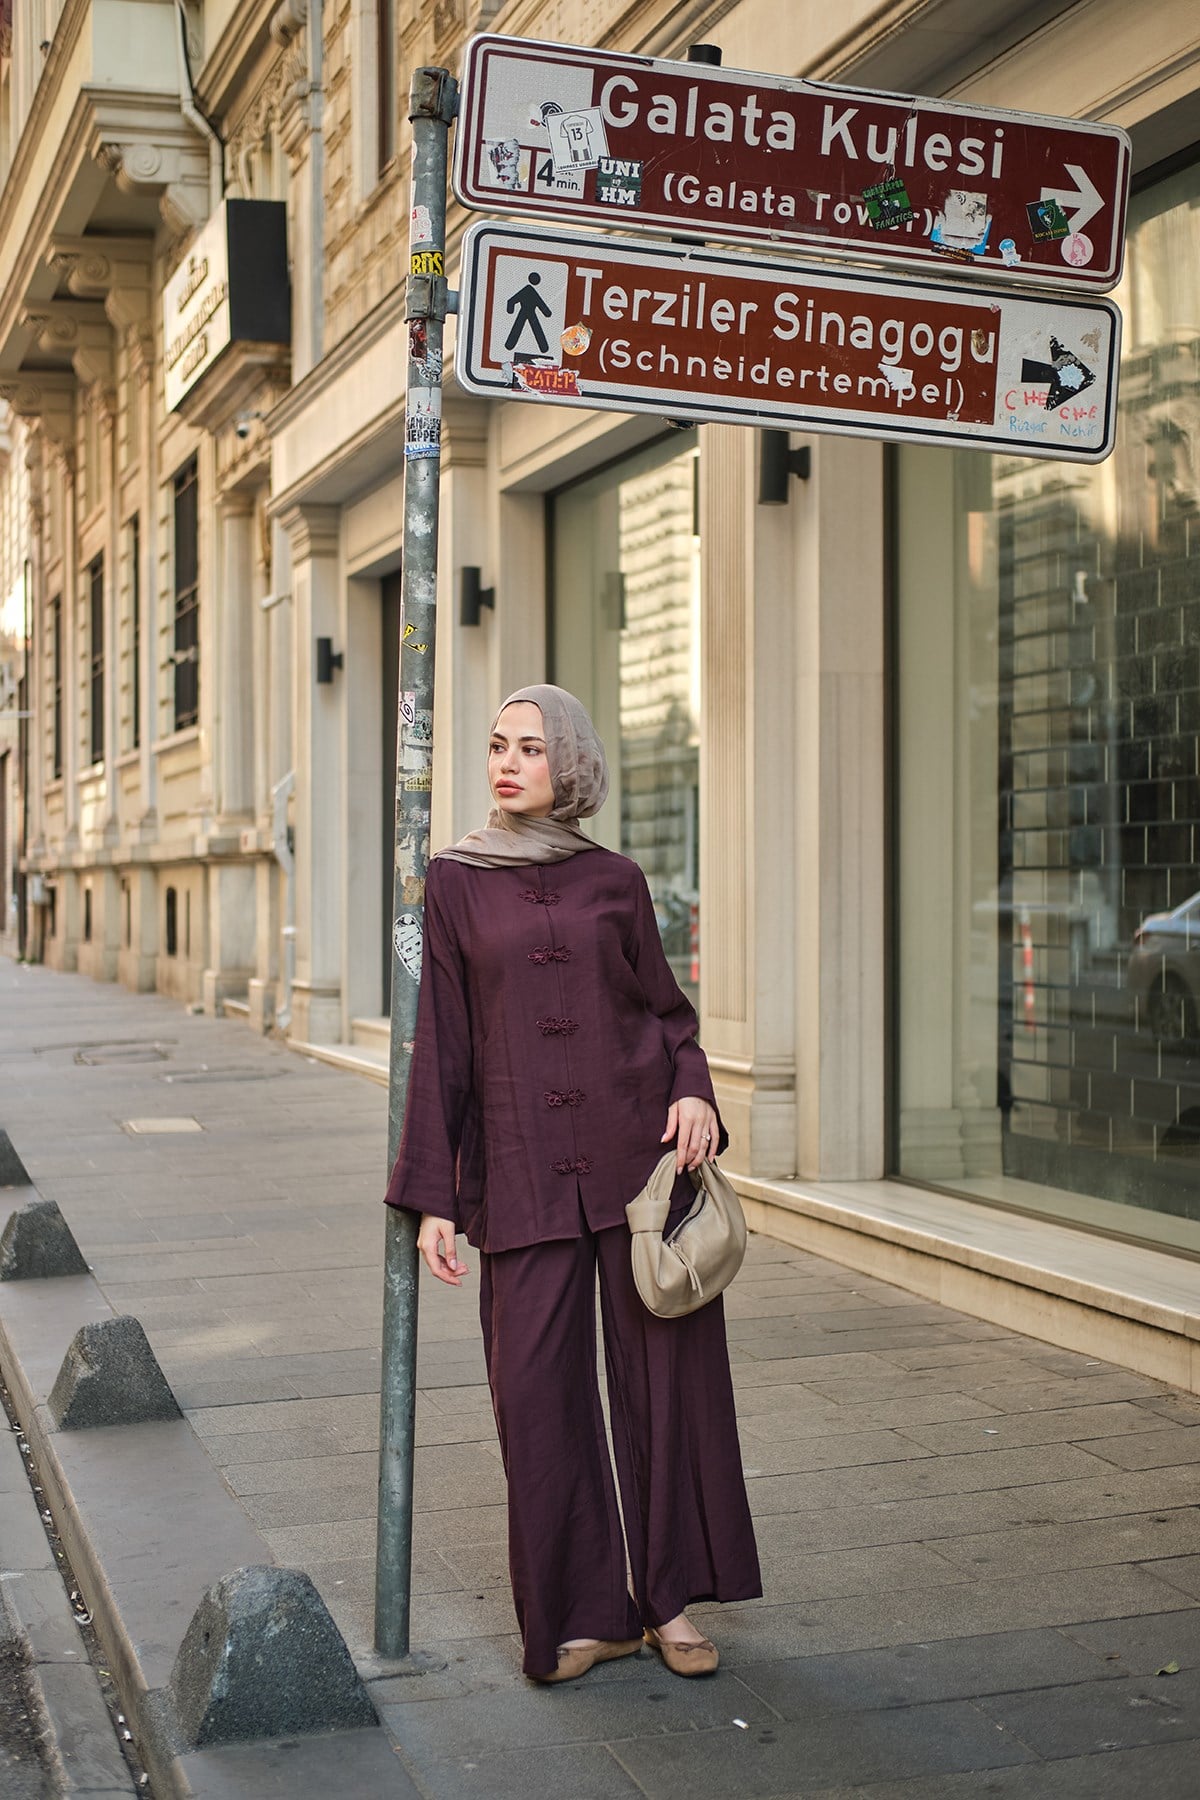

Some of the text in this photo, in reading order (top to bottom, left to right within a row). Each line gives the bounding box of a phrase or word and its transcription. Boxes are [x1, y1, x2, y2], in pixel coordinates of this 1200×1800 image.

[571, 127, 583, 141] 13
[600, 75, 1004, 179] Galata Kulesi
[536, 158, 556, 187] 4
[556, 179, 581, 191] min.
[600, 158, 641, 178] UNI
[600, 186, 636, 205] HM
[663, 173, 796, 217] (Galata
[874, 211, 914, 230] FANATICS
[575, 266, 996, 373] Terziler Sinagogu
[599, 337, 965, 413] (Schneidertempel)
